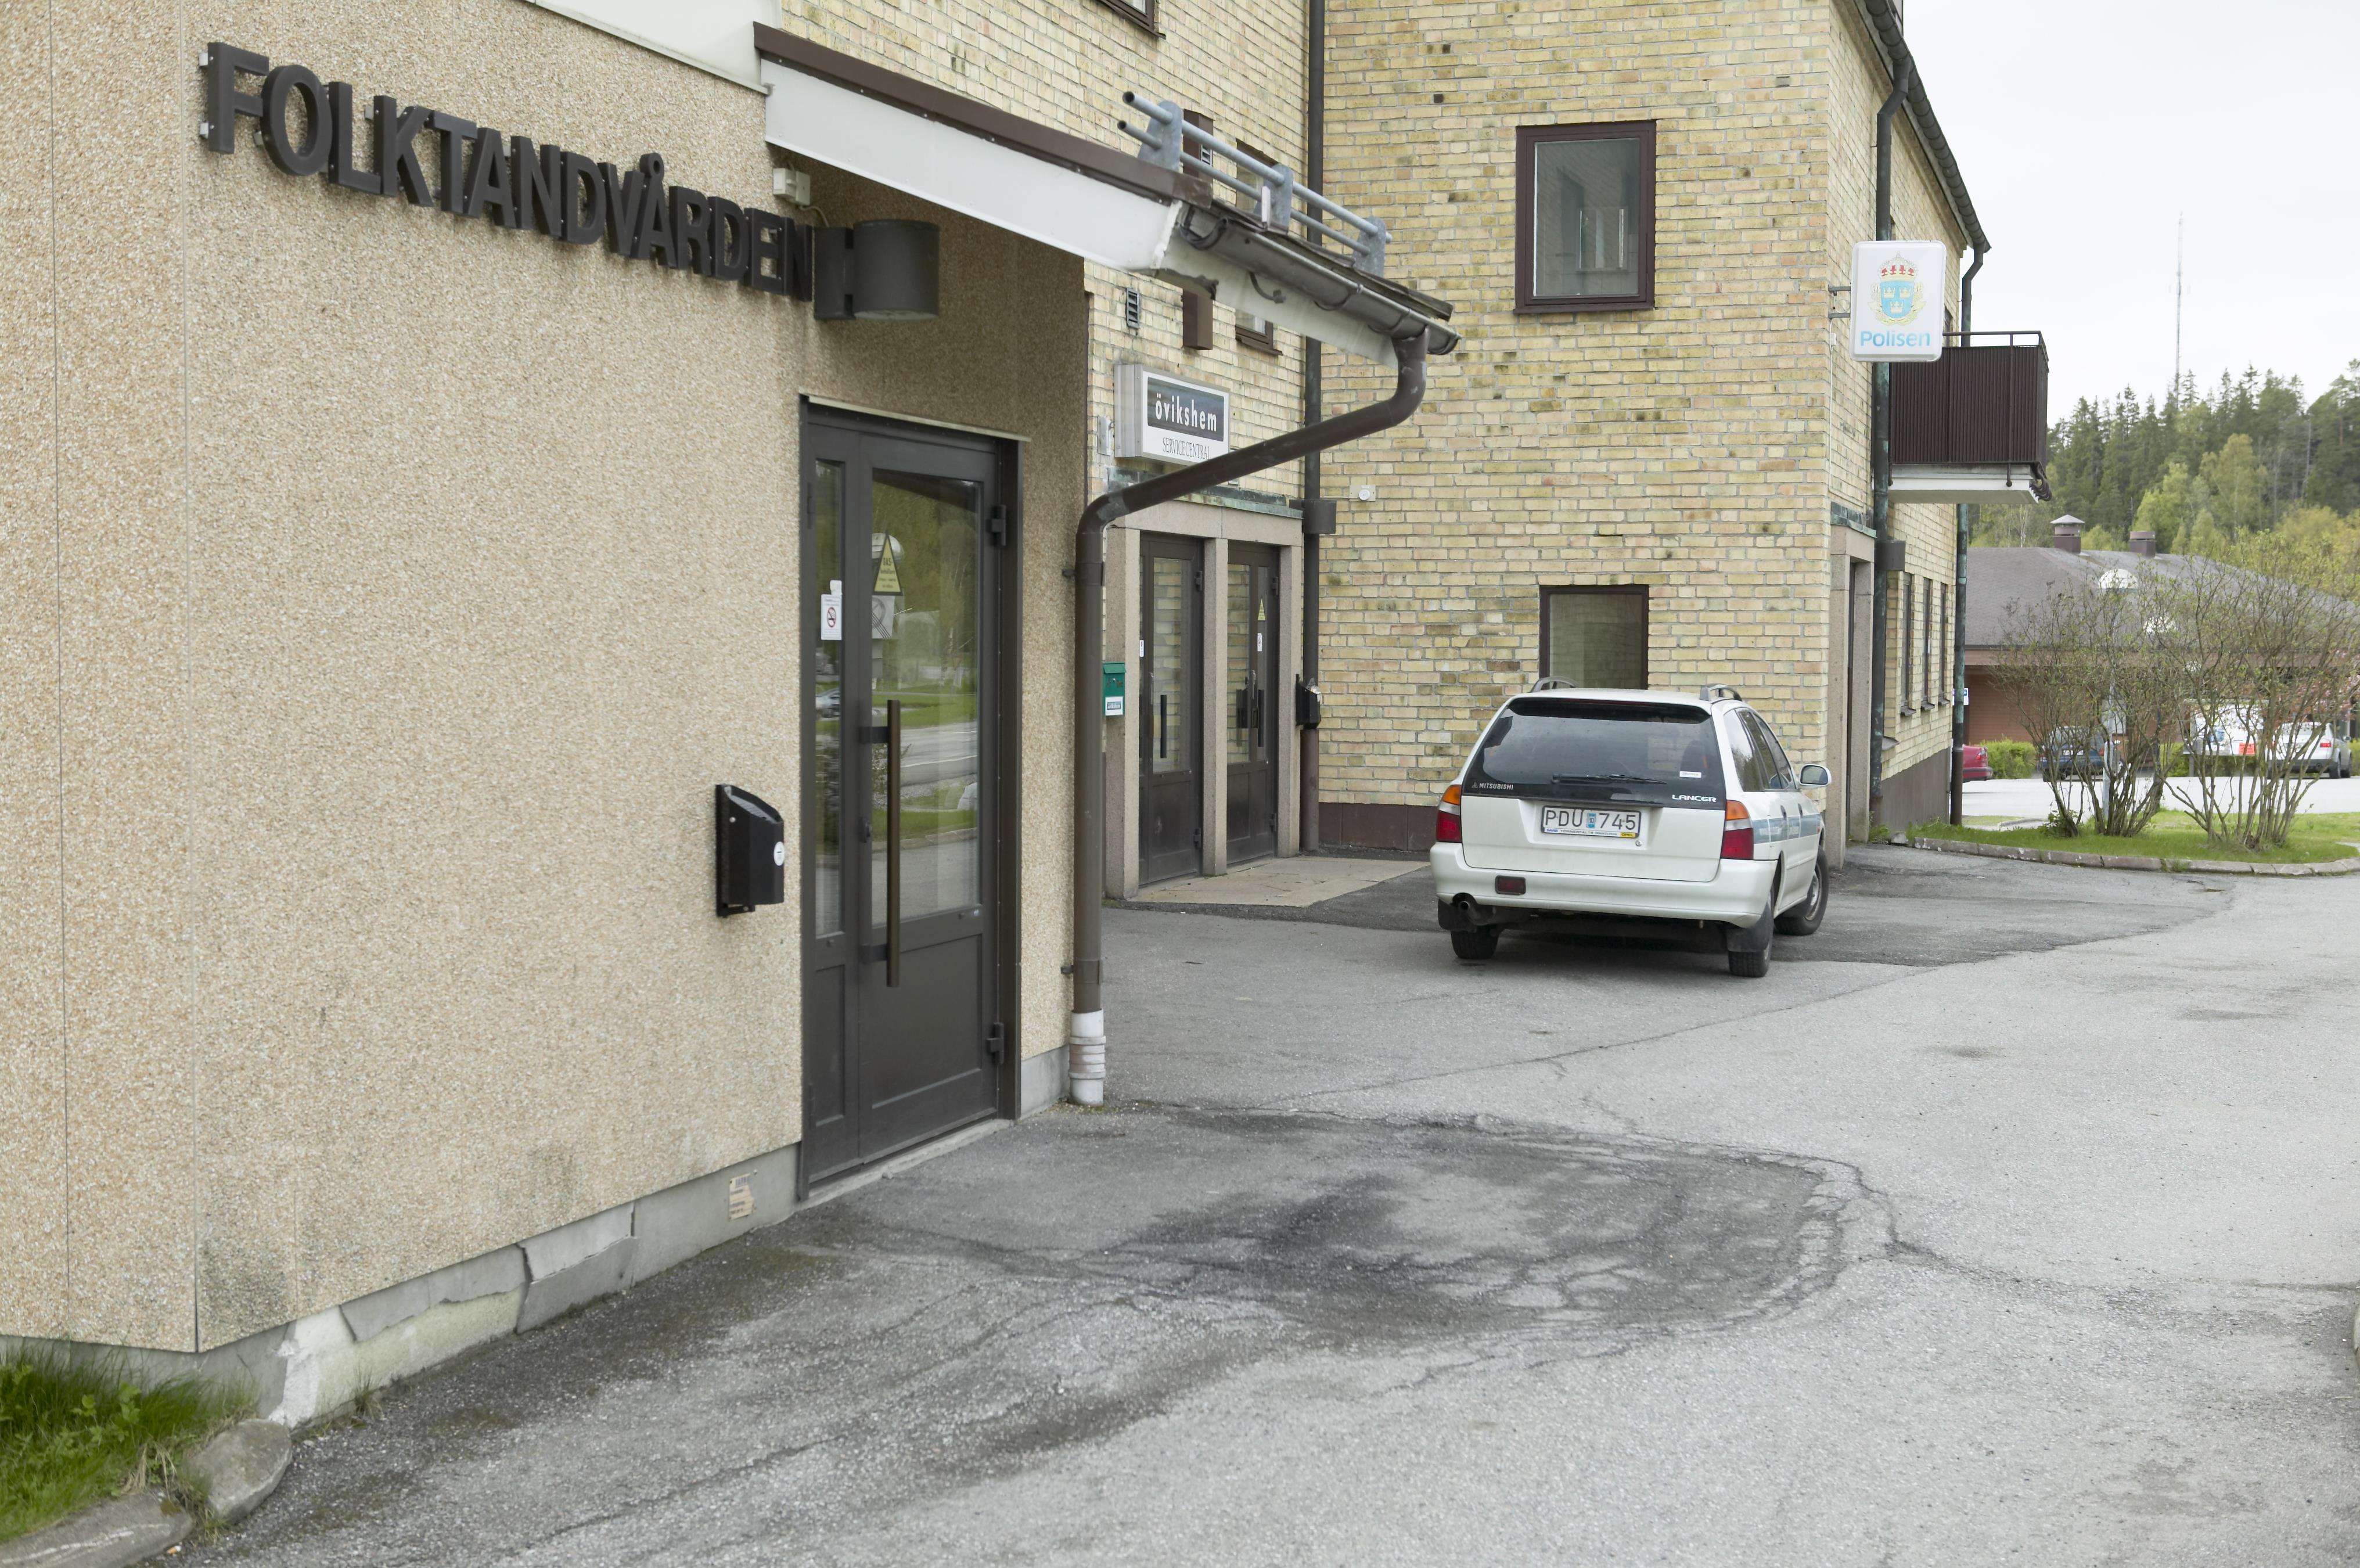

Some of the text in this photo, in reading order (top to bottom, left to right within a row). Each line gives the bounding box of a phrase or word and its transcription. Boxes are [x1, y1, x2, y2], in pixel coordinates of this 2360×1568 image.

[207, 42, 814, 301] FOLKTANDVÅRDEN
[1860, 330, 1930, 347] Polisen
[1155, 393, 1217, 431] övikshem
[1479, 782, 1514, 790] MITSUBISHI
[1672, 794, 1717, 803] LANCER
[1545, 809, 1636, 830] PDU 745
